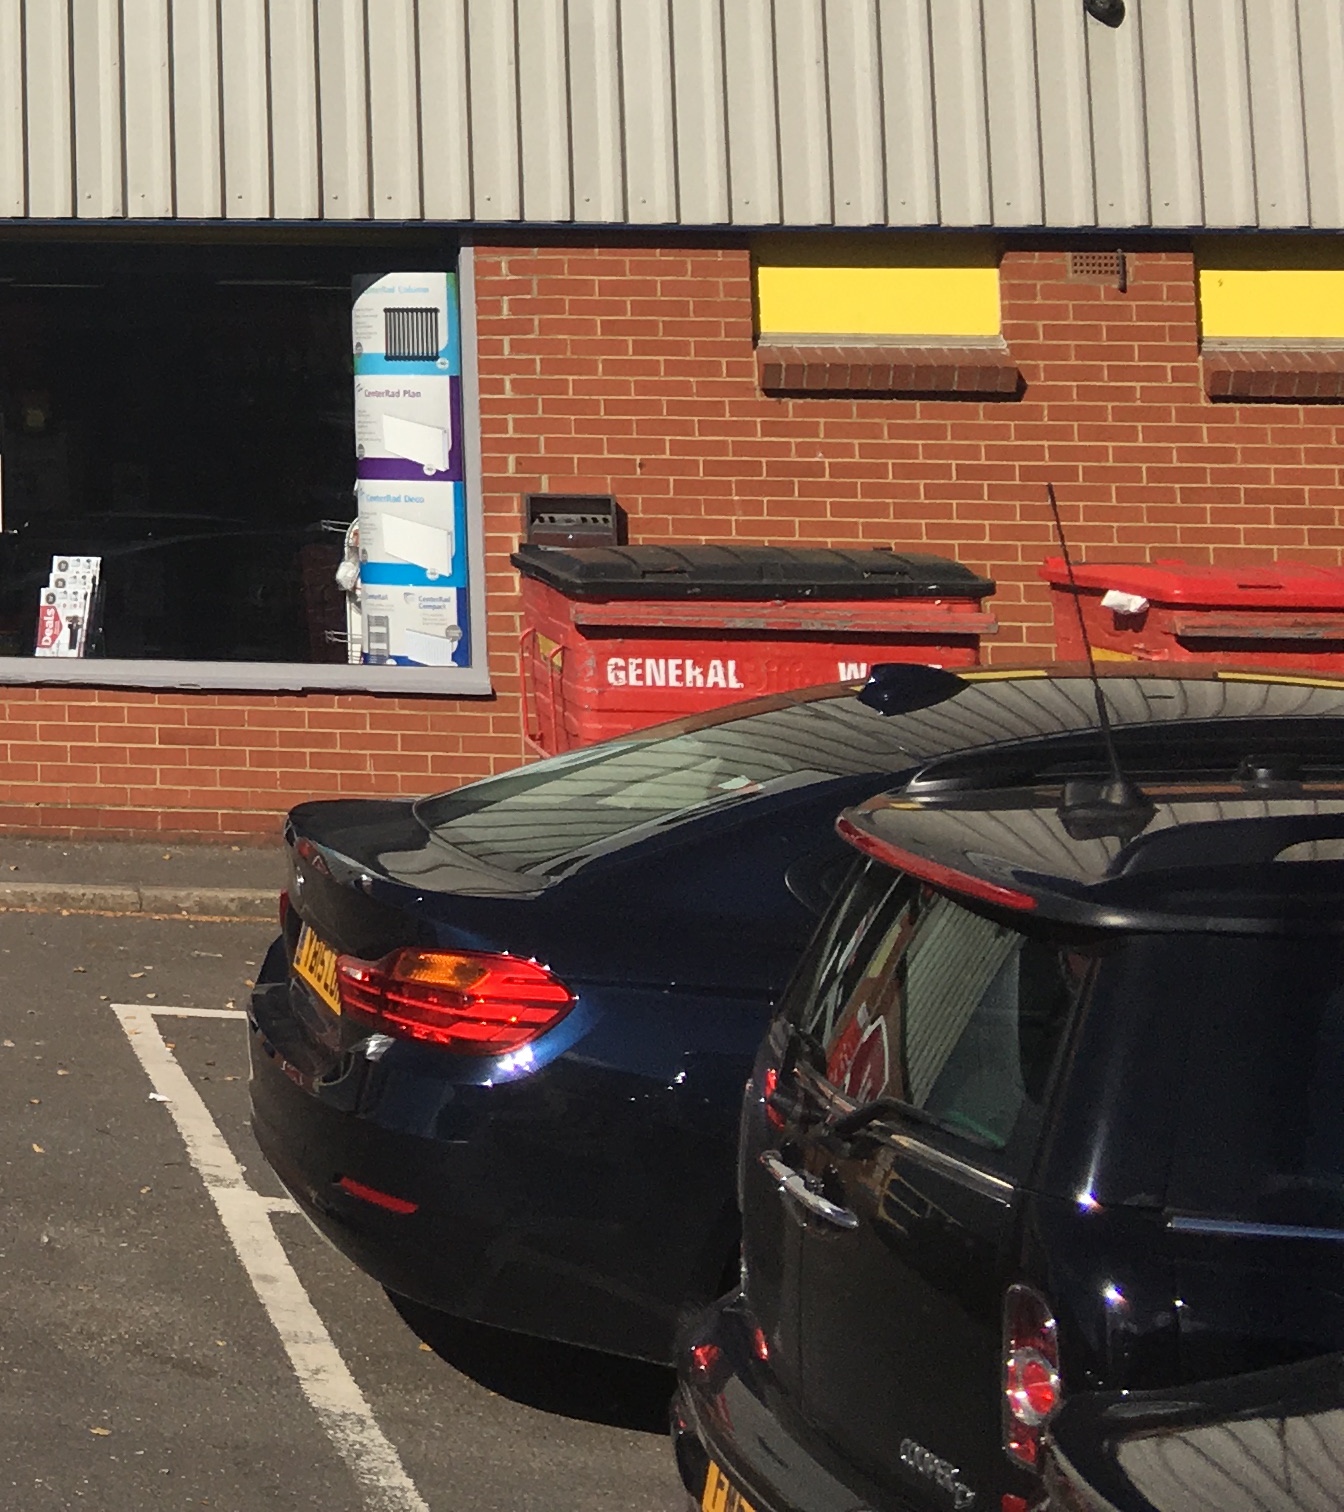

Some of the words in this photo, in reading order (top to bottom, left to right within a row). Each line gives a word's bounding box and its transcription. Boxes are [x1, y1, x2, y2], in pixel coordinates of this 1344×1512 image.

[364, 389, 400, 398] CenterRad
[403, 389, 421, 398] Plan
[404, 495, 424, 503] Deco
[41, 608, 56, 646] Deals
[607, 657, 744, 688] GENERAL
